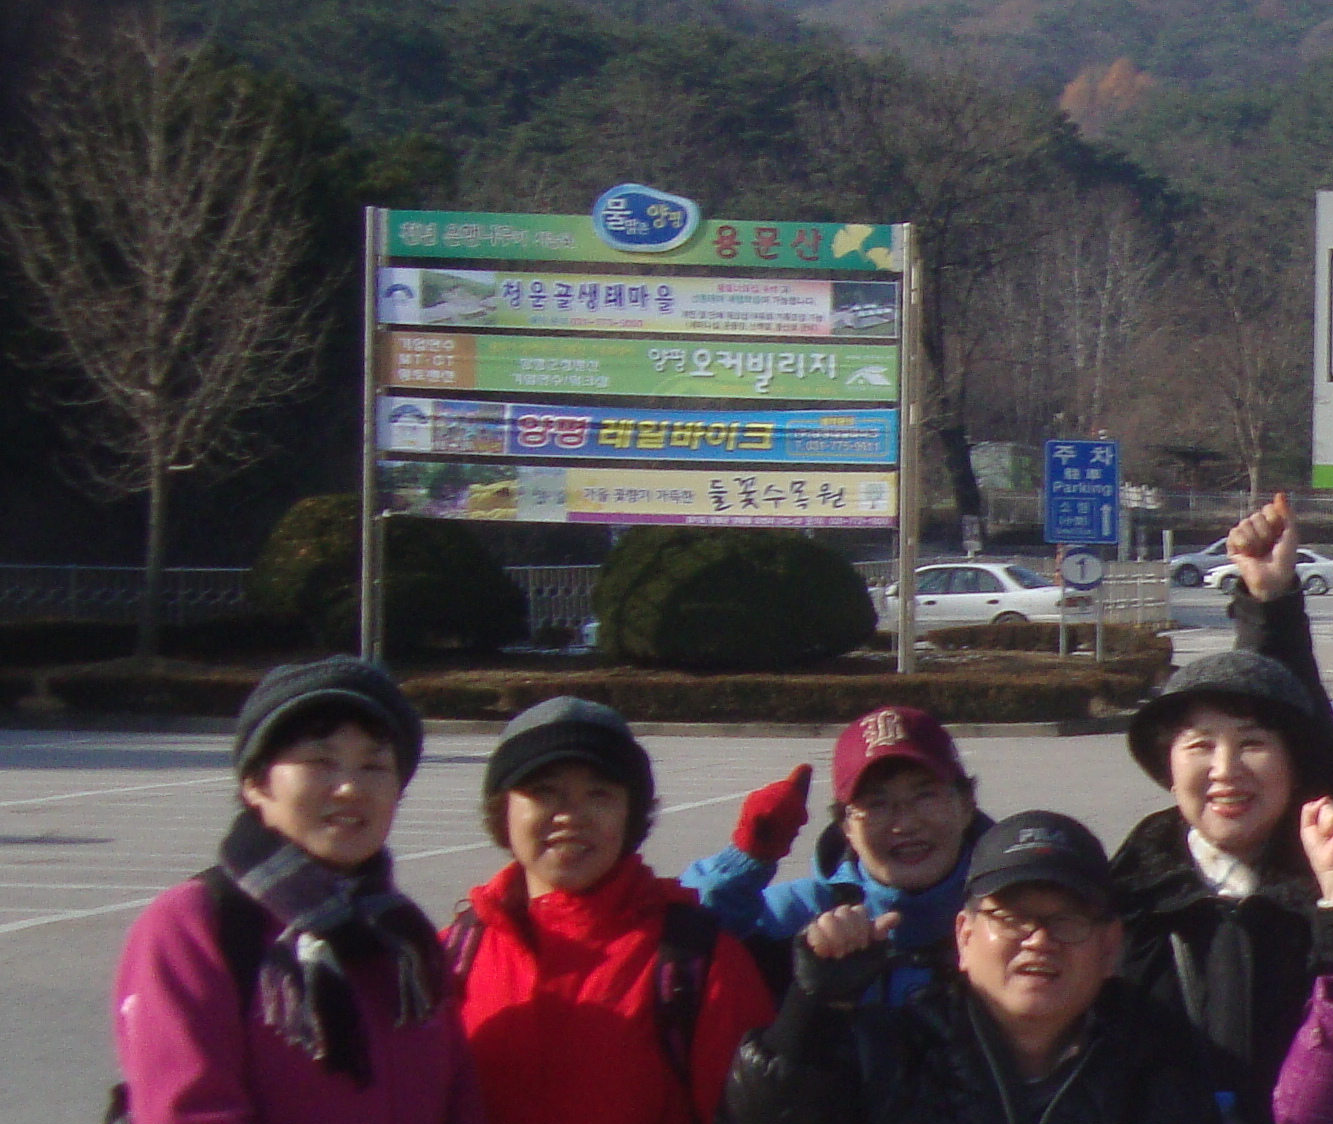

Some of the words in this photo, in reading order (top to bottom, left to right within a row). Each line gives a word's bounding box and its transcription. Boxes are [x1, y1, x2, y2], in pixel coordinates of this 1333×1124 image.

[647, 204, 684, 229] 양평
[712, 225, 824, 262] 용문산
[648, 347, 686, 373] 양평
[689, 348, 837, 394] 오커빌리지
[518, 413, 594, 449] 양평
[597, 418, 776, 452] 레일바이크
[1052, 445, 1115, 466] 주차
[708, 476, 847, 513] 들꽃수목원
[1053, 481, 1114, 498] Parking
